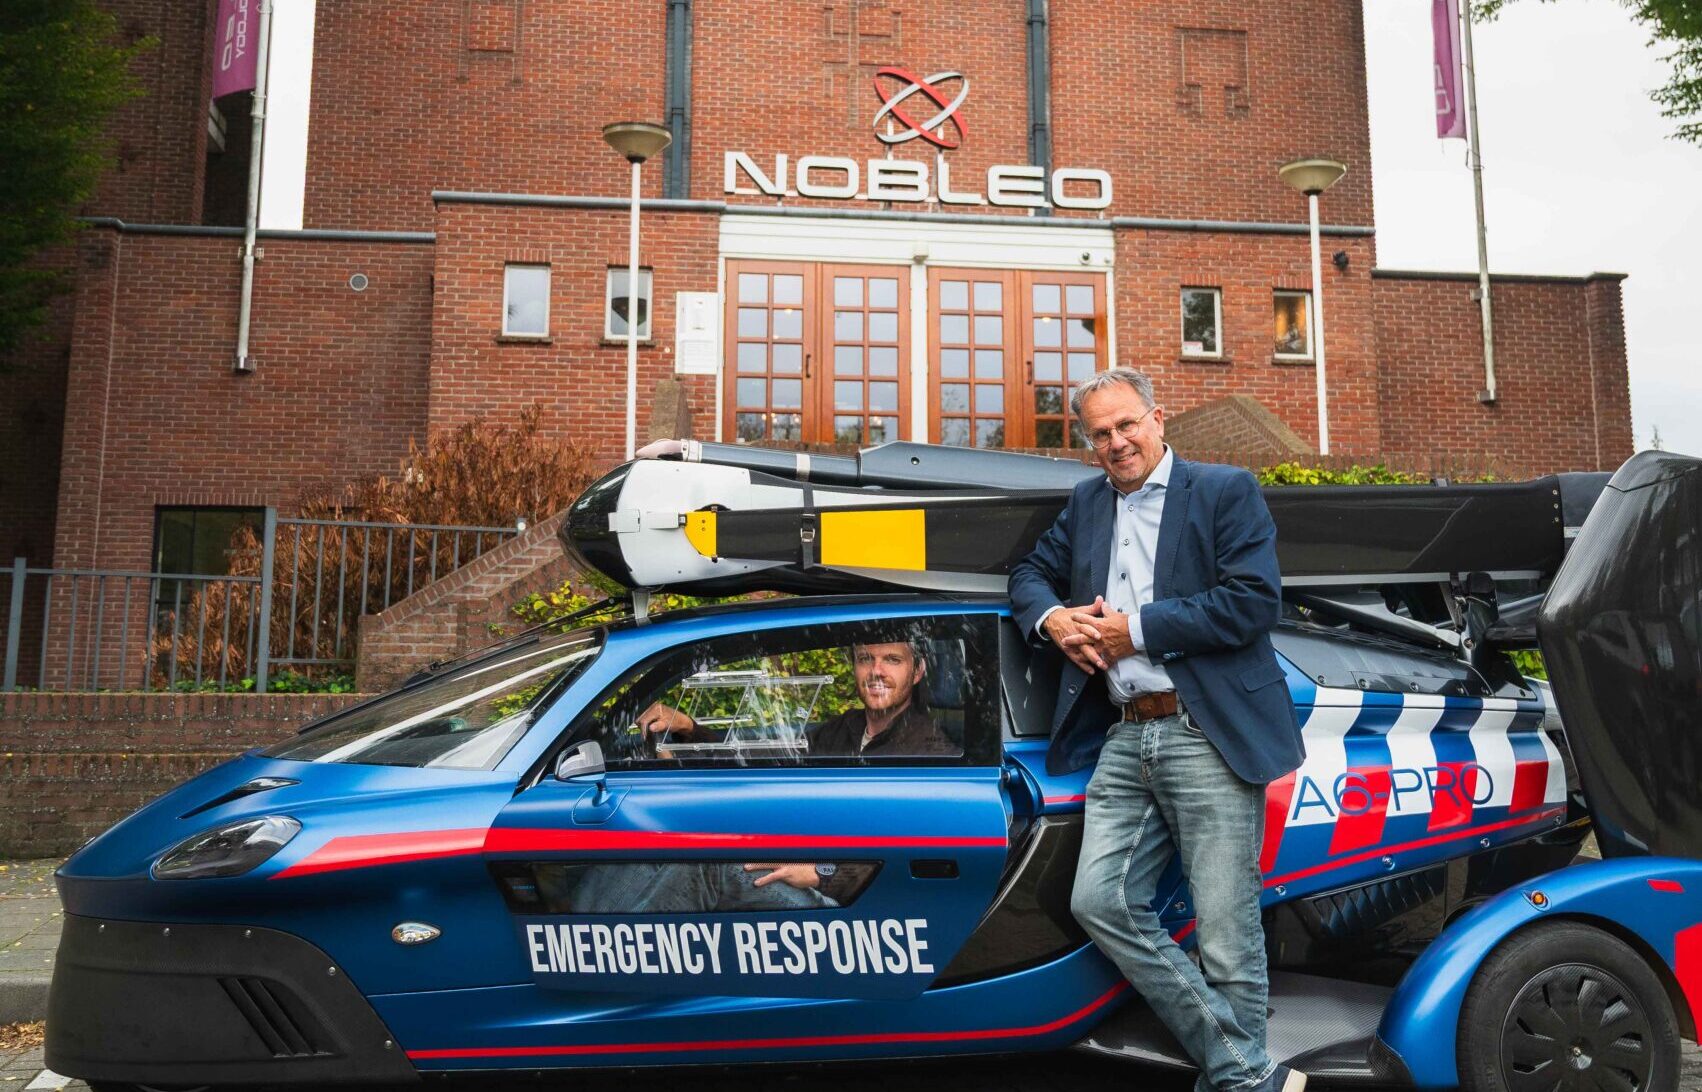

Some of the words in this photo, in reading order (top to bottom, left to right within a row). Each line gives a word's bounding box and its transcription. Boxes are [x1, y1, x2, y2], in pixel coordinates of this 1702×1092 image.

[724, 151, 1113, 209] NOBLEO
[1292, 764, 1494, 820] A6-PRO
[526, 922, 722, 975] EMERGENCY
[732, 918, 935, 974] RESPONSE
